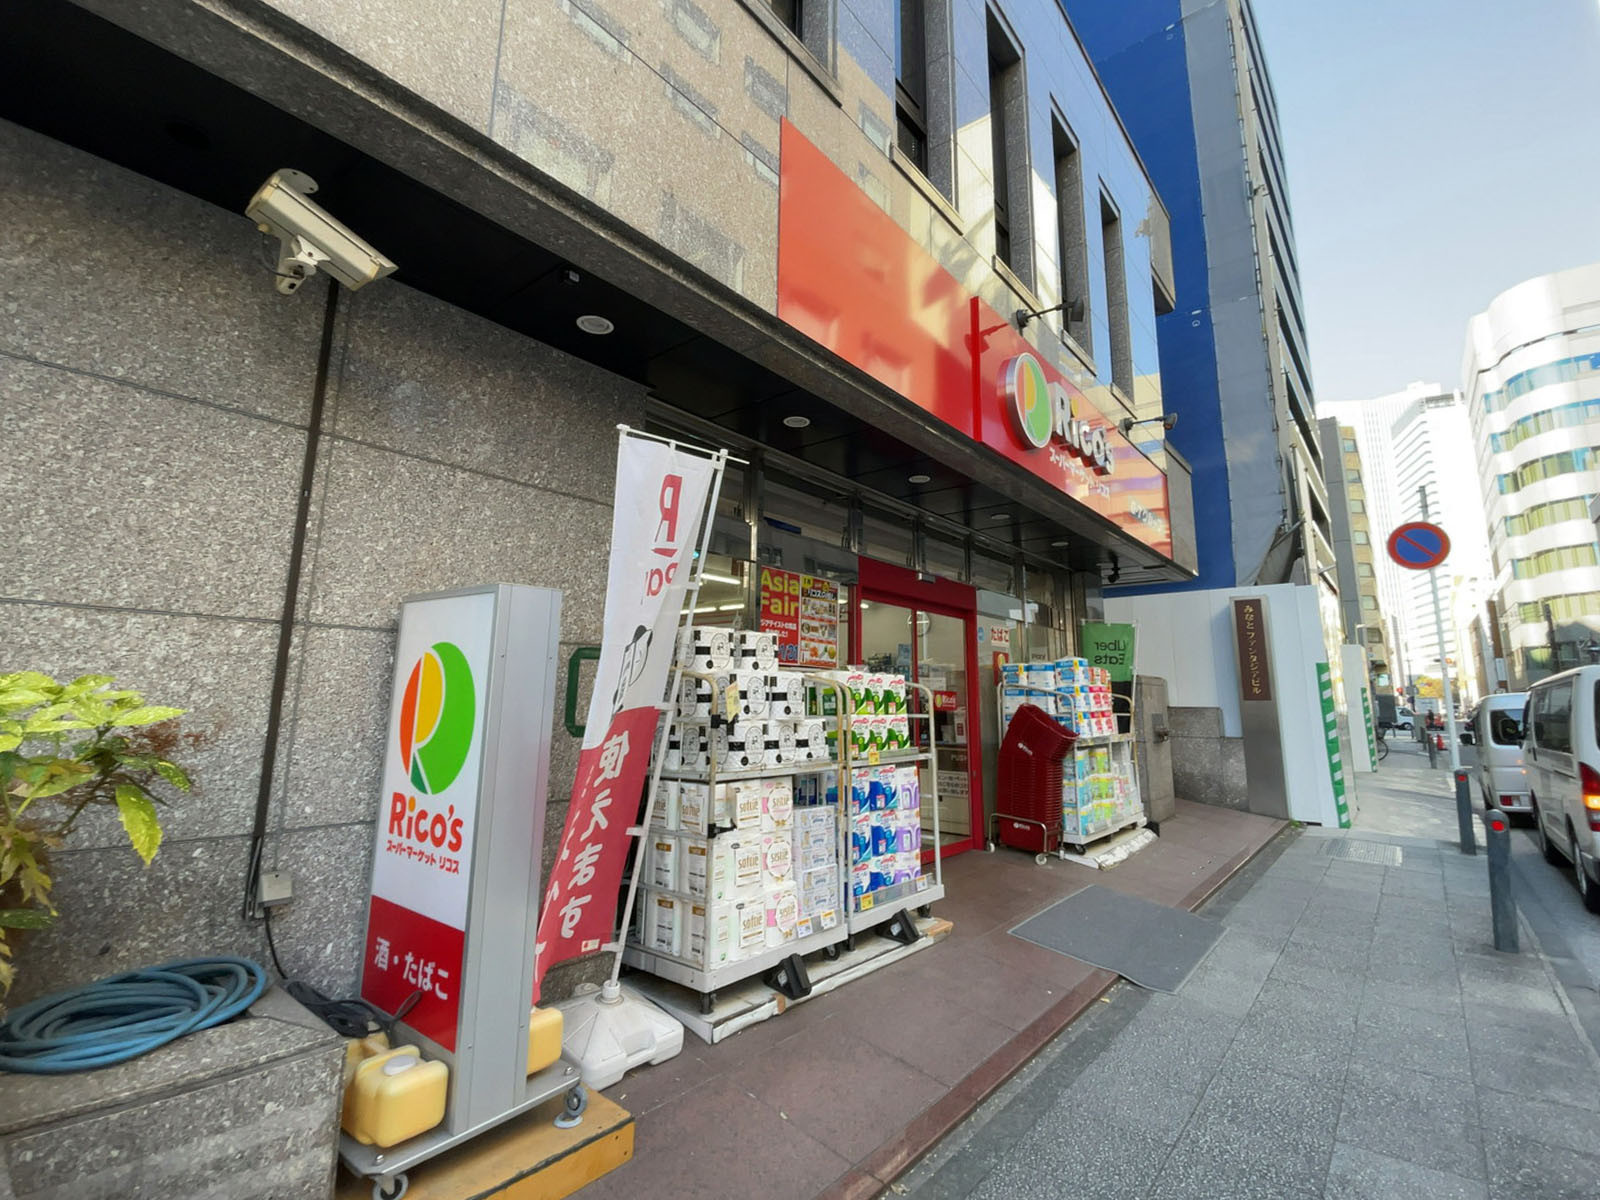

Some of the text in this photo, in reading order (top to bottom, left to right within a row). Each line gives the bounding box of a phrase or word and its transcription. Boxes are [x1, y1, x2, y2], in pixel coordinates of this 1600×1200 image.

[760, 567, 799, 594] Asia
[760, 592, 799, 617] Fair
[991, 628, 1010, 644] たばこ
[389, 792, 463, 853] Rico's
[386, 839, 461, 875] スーパーマーケット リコス
[374, 936, 450, 1001] 酒・たばこ
